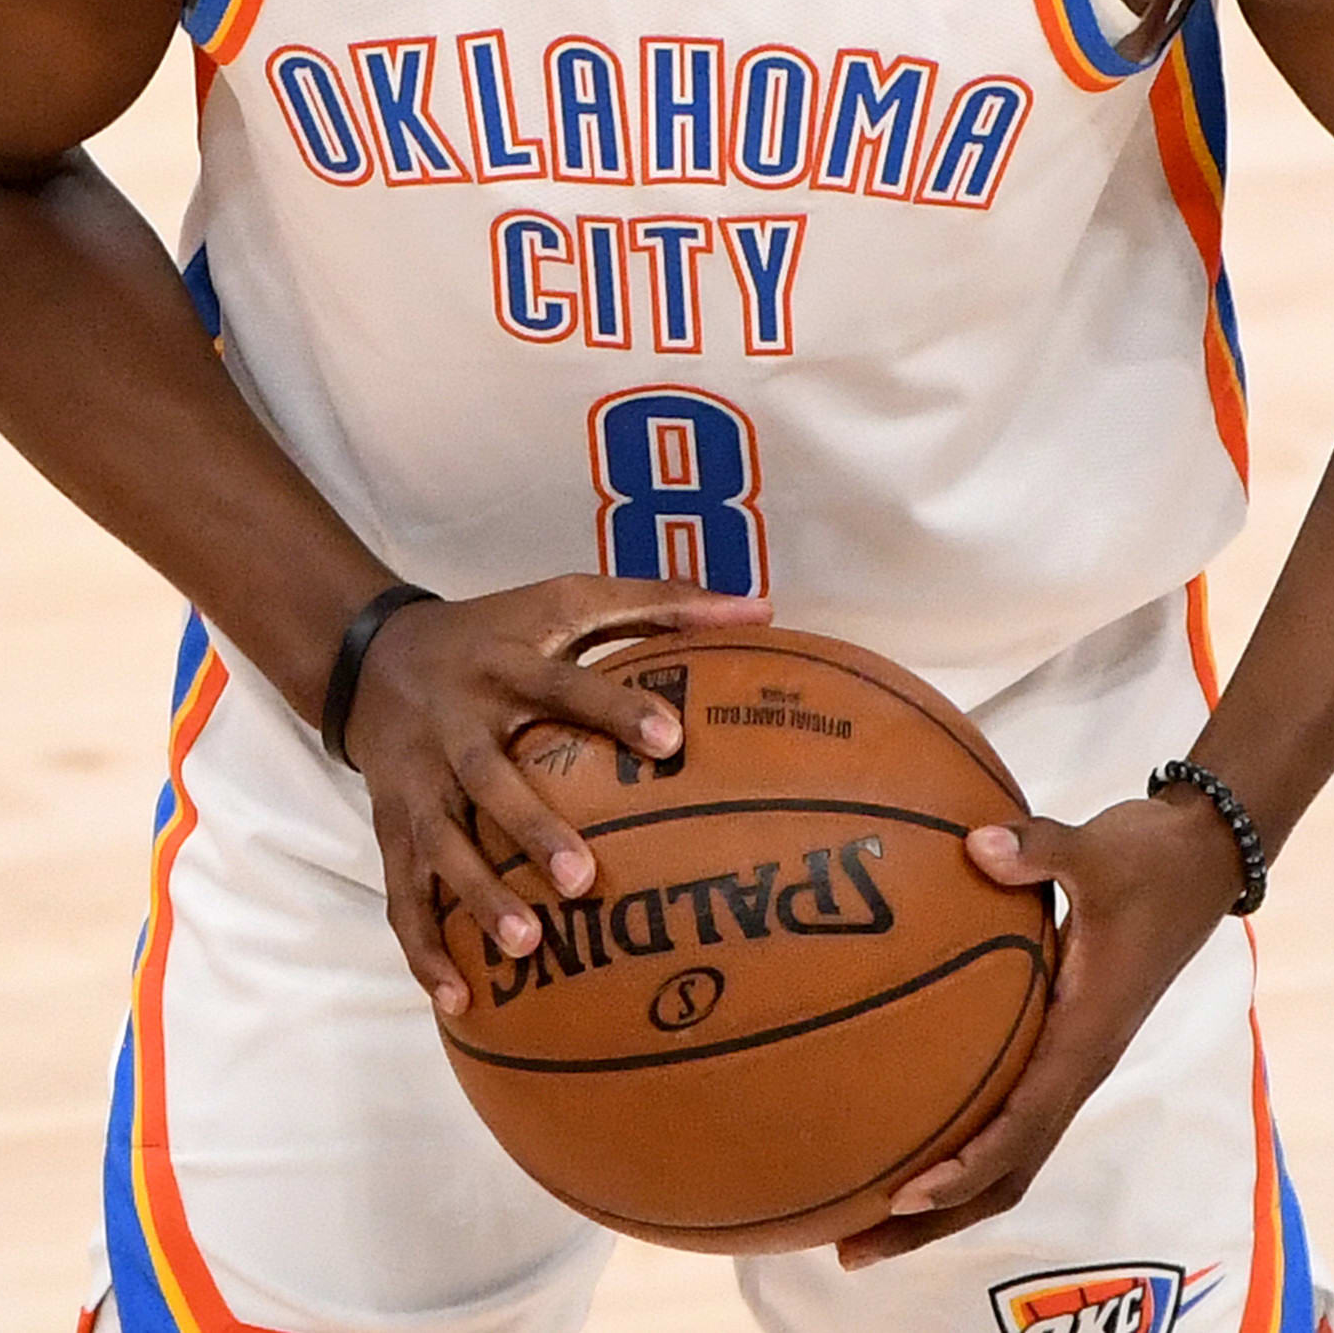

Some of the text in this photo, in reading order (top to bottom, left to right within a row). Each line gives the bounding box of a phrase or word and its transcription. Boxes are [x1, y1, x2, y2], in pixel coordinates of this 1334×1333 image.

[266, 29, 1034, 210] OKLAHOMA
[490, 208, 808, 356] CITY
[587, 382, 771, 600] 8
[706, 706, 852, 739] OFFICIAL GAME BALL
[677, 979, 696, 1020] S
